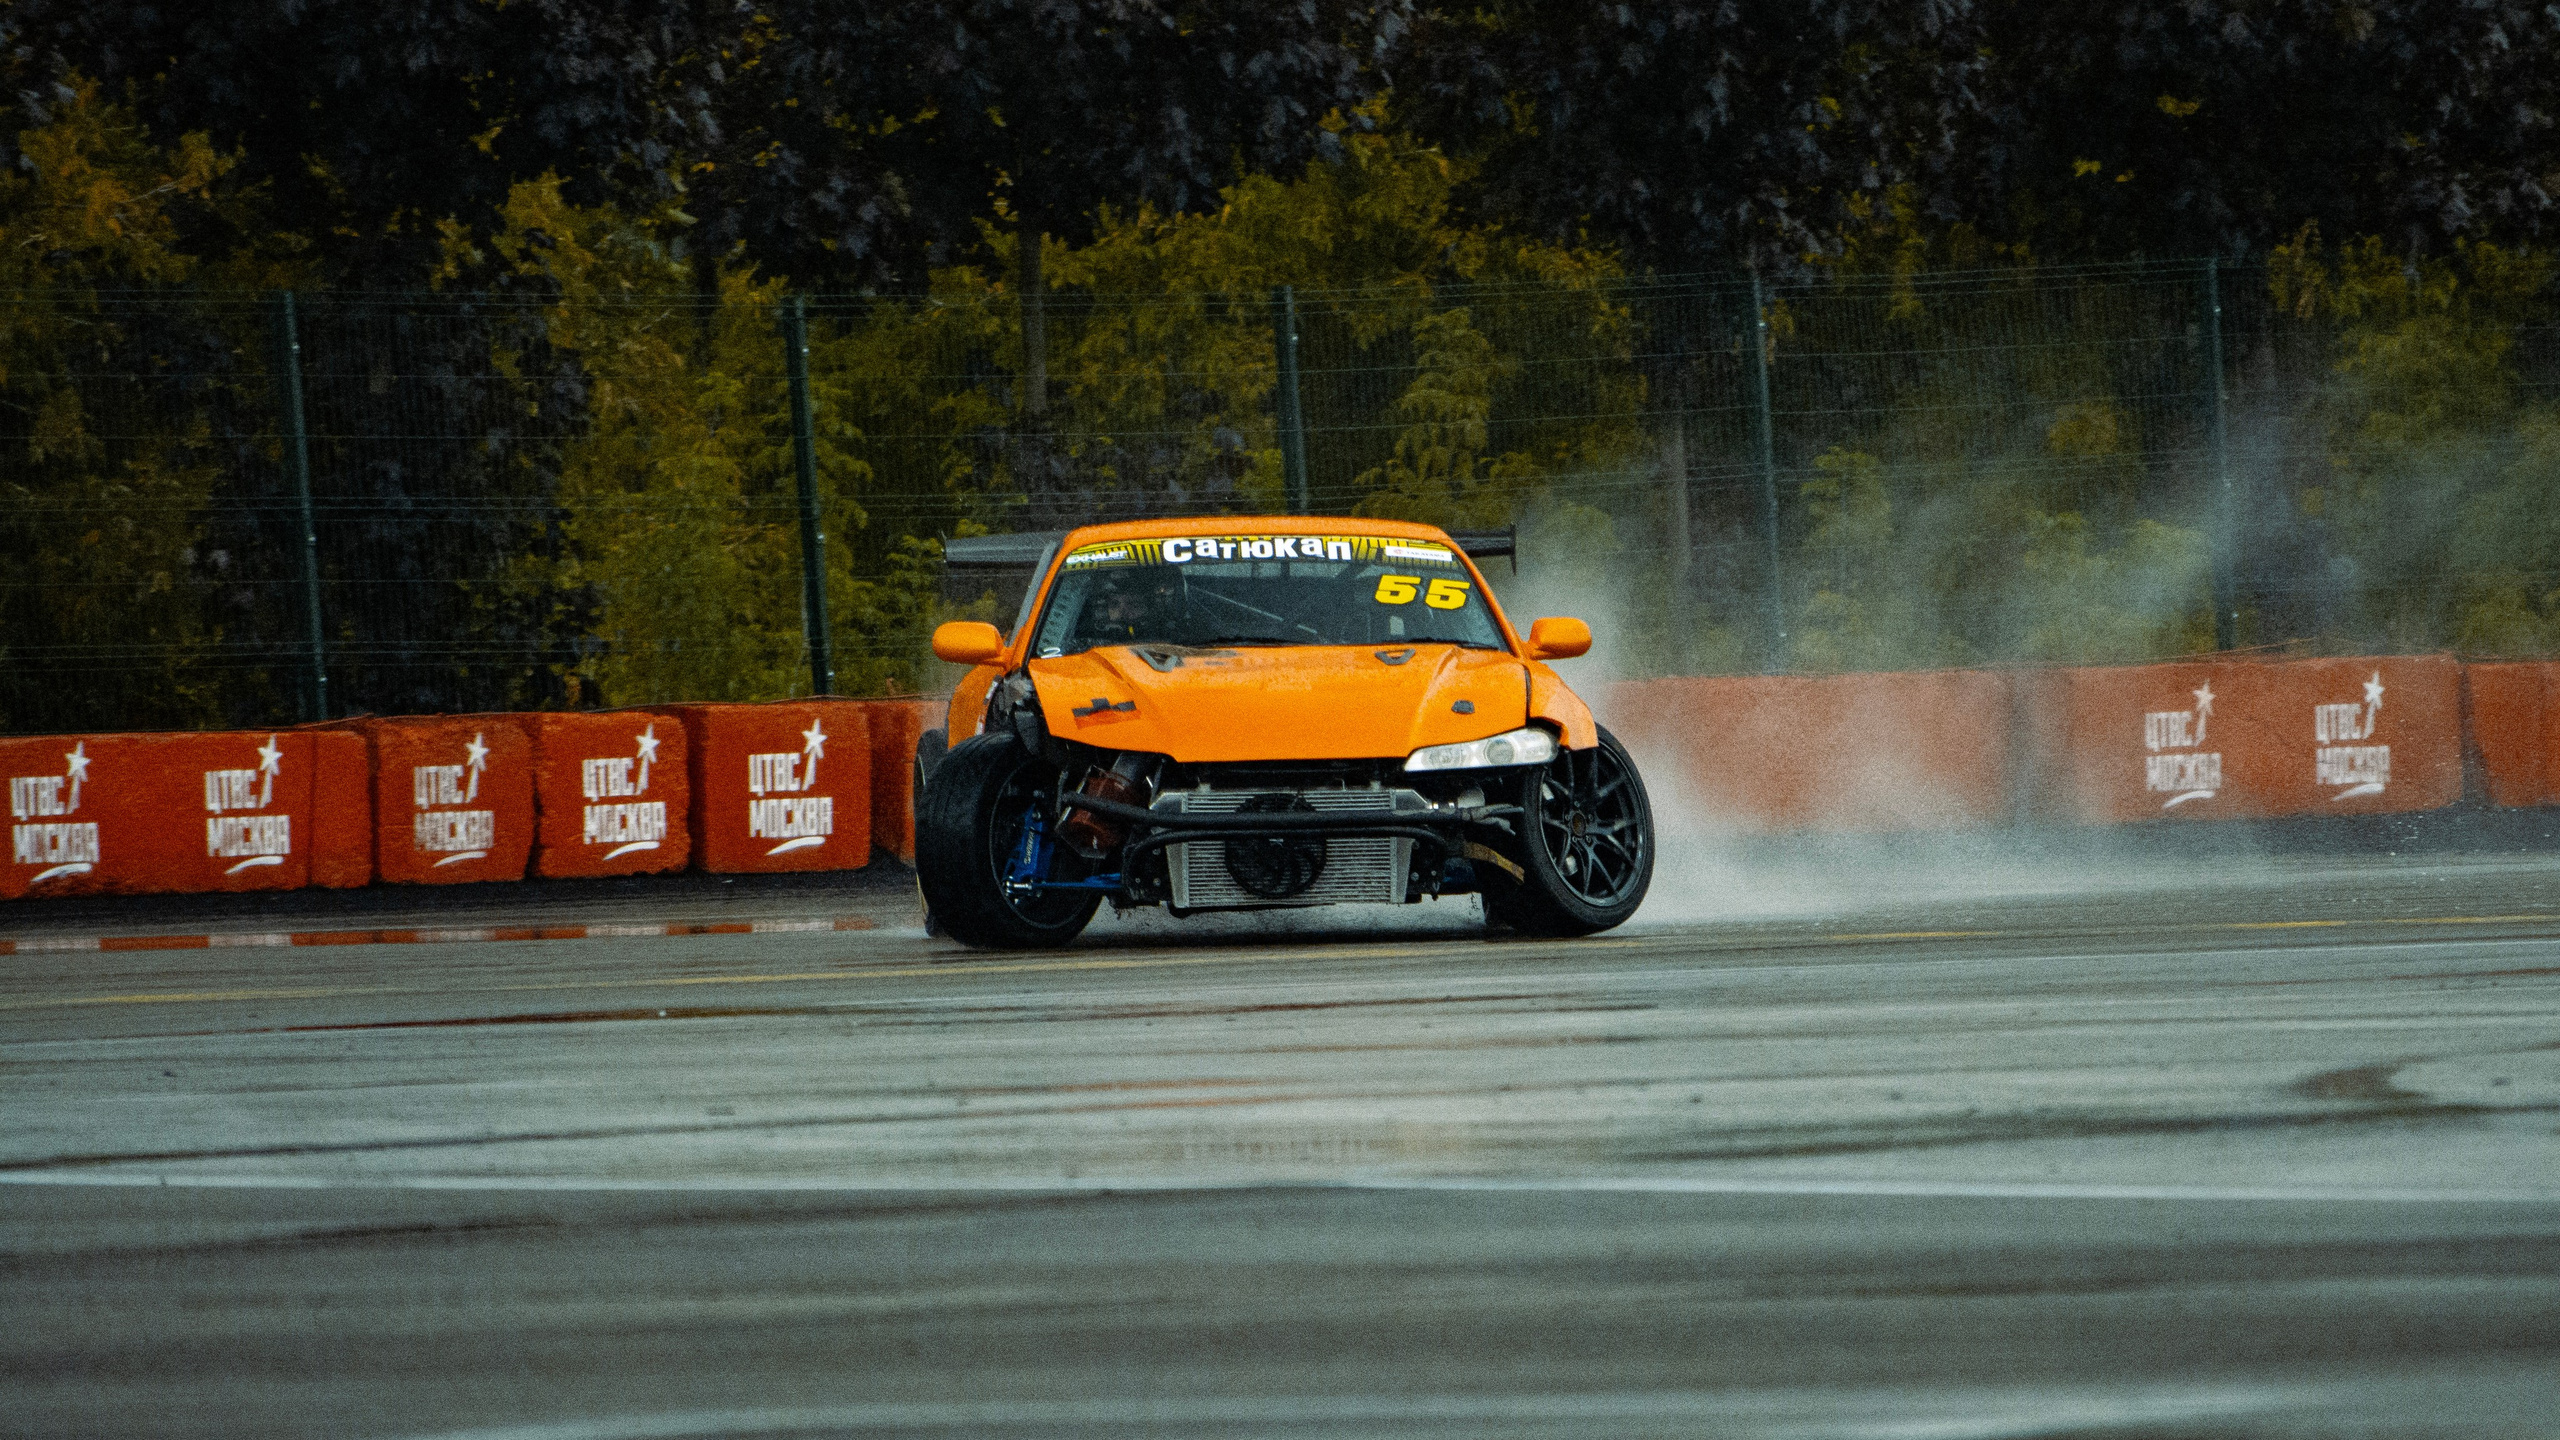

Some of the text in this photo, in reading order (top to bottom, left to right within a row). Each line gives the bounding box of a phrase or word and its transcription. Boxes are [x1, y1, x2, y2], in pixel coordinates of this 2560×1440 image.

[1374, 574, 1471, 610] 55
[206, 815, 291, 857] МОСКВА
[583, 801, 667, 845] МОСКВА
[749, 797, 834, 838] МОСКВА
[13, 822, 100, 863] МОСКВА
